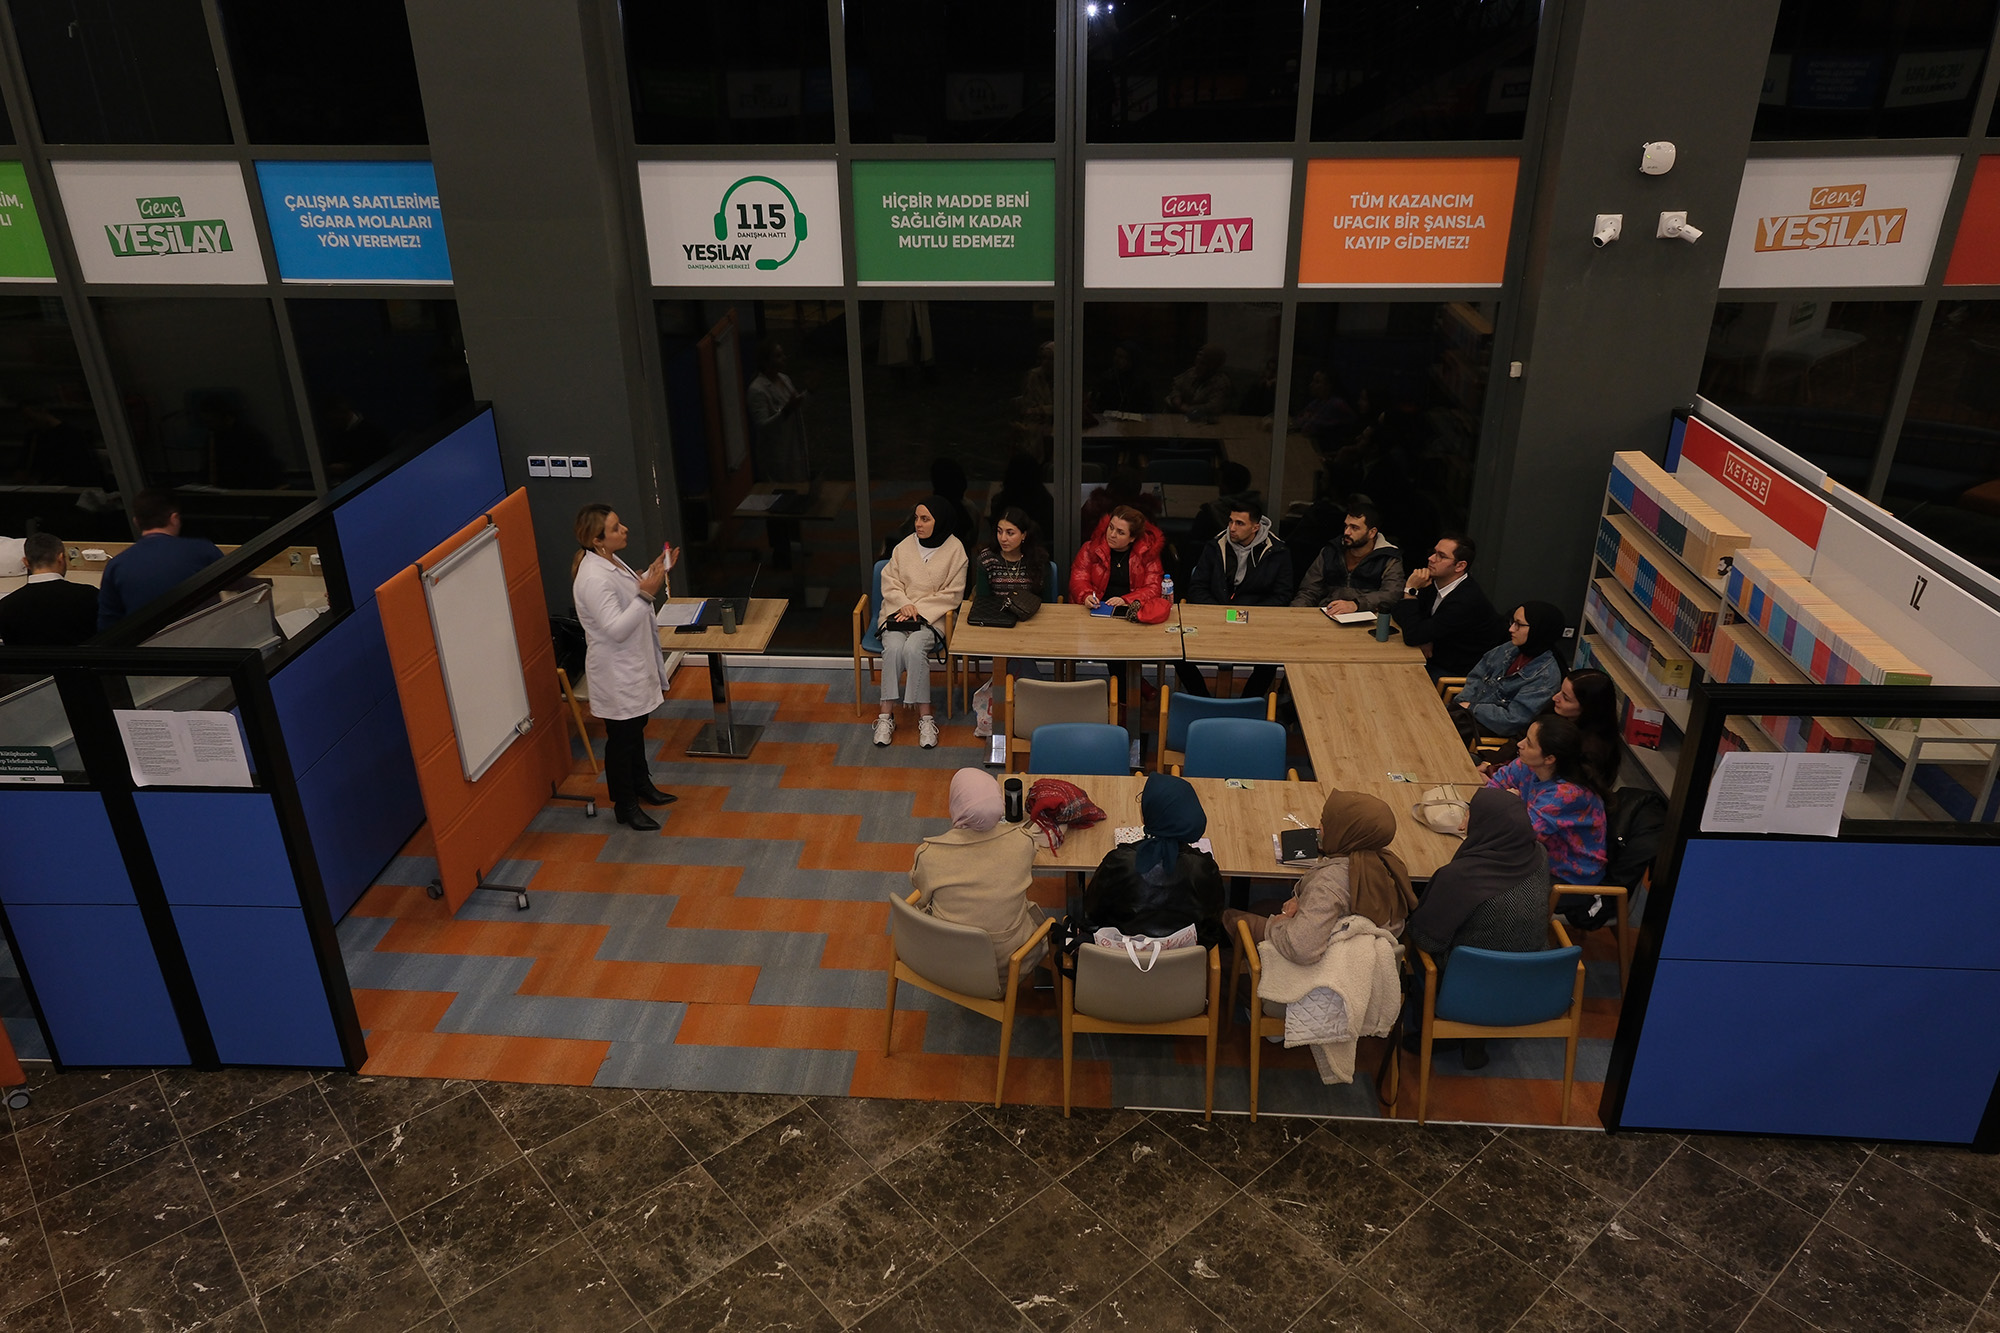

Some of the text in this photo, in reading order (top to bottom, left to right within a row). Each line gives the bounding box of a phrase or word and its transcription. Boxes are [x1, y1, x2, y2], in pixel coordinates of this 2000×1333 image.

[284, 192, 440, 212] ÇALIŞMA SAATLERİME
[882, 191, 1030, 211] HİÇBİR MADDE BENİ
[1164, 197, 1208, 217] Genç
[1350, 192, 1474, 208] TÜM KAZANCIM
[1812, 188, 1861, 207] Genç
[141, 199, 181, 218] Genç
[736, 204, 787, 230] 115
[299, 212, 432, 229] SİGARA MOLALARI
[891, 212, 1022, 229] SAĞLIĞIM KADAR
[1333, 212, 1486, 232] UFACIK BİR ŞANSLA
[317, 232, 422, 248] YÖN VEREMEZ!
[899, 235, 1015, 248] MUTLU EDEMEZ!
[1344, 233, 1470, 249] KAYIP GİDEMEZ!
[1727, 459, 1767, 497] KETEBE
